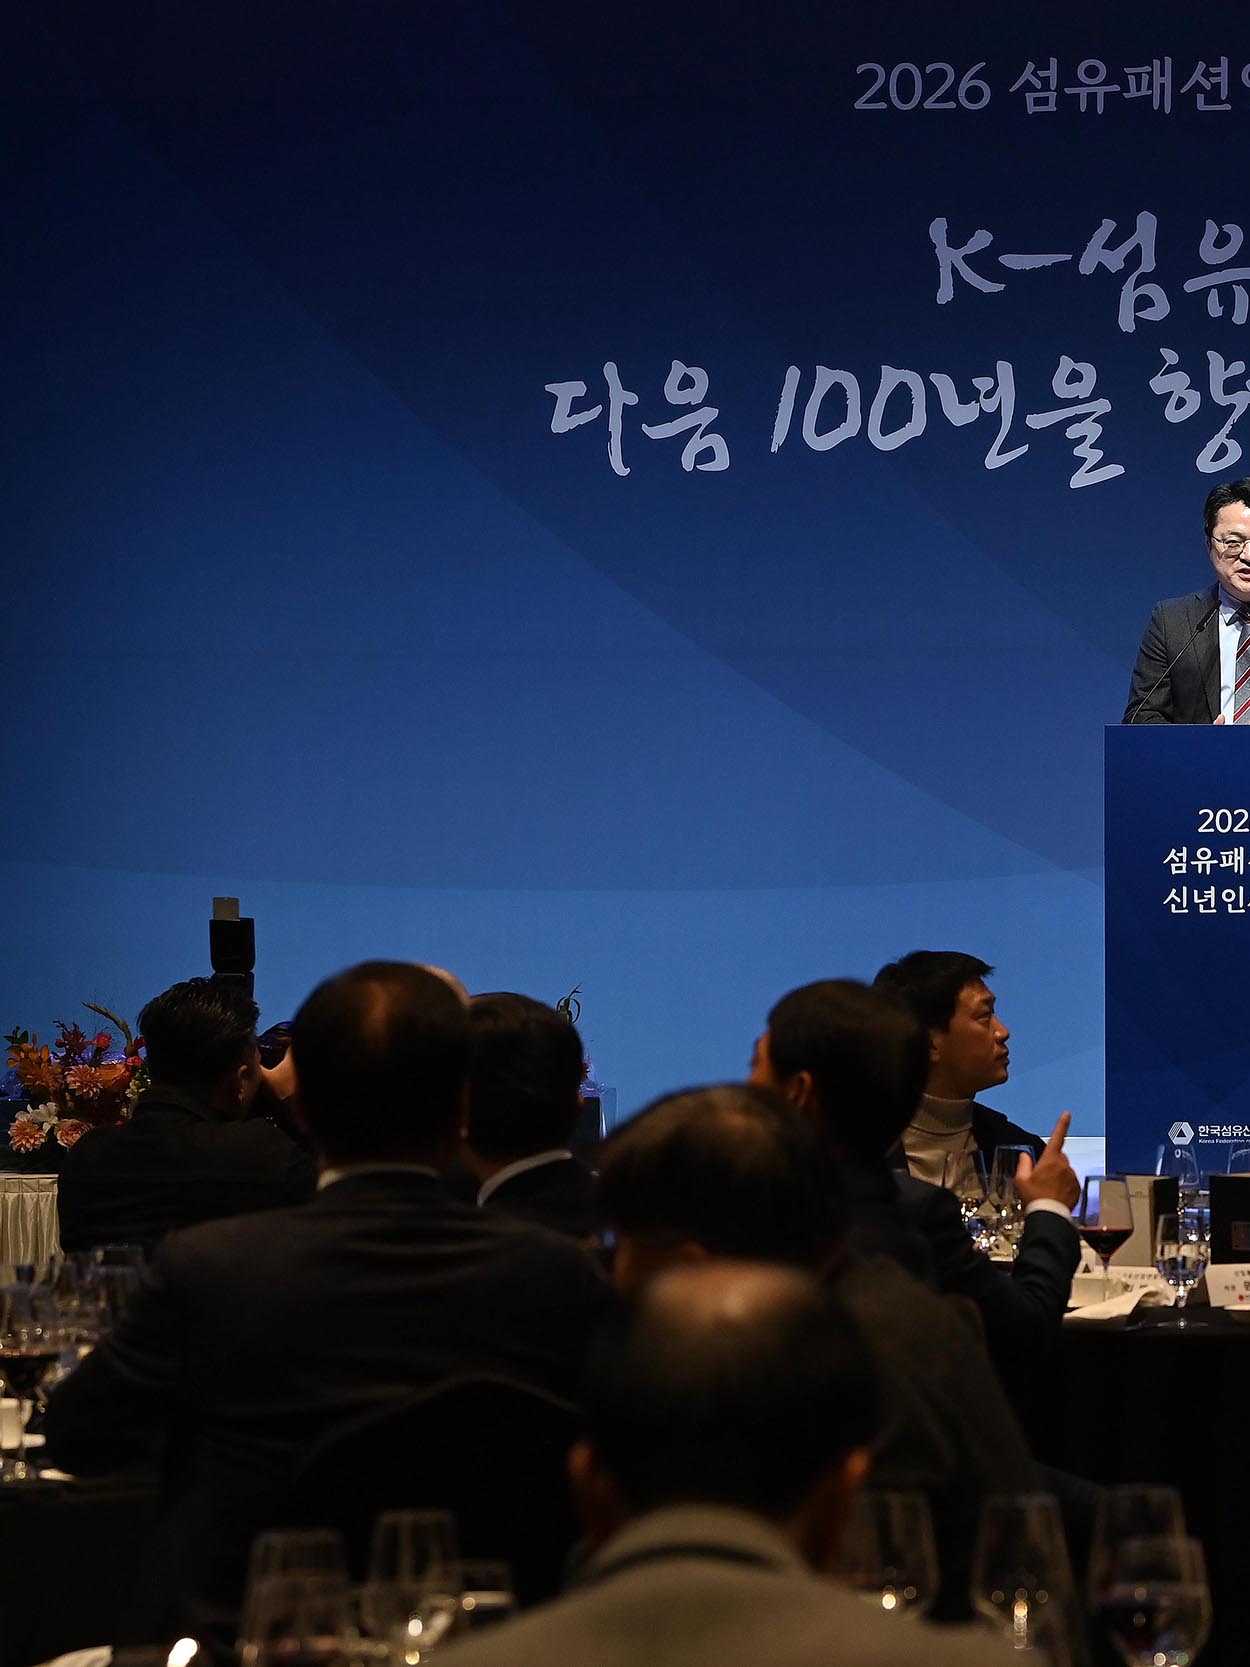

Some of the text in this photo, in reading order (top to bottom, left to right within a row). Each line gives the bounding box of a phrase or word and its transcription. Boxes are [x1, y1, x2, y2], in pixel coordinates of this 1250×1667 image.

[853, 61, 992, 111] 2026
[544, 359, 731, 477] 다음
[770, 354, 1126, 489] 100년을
